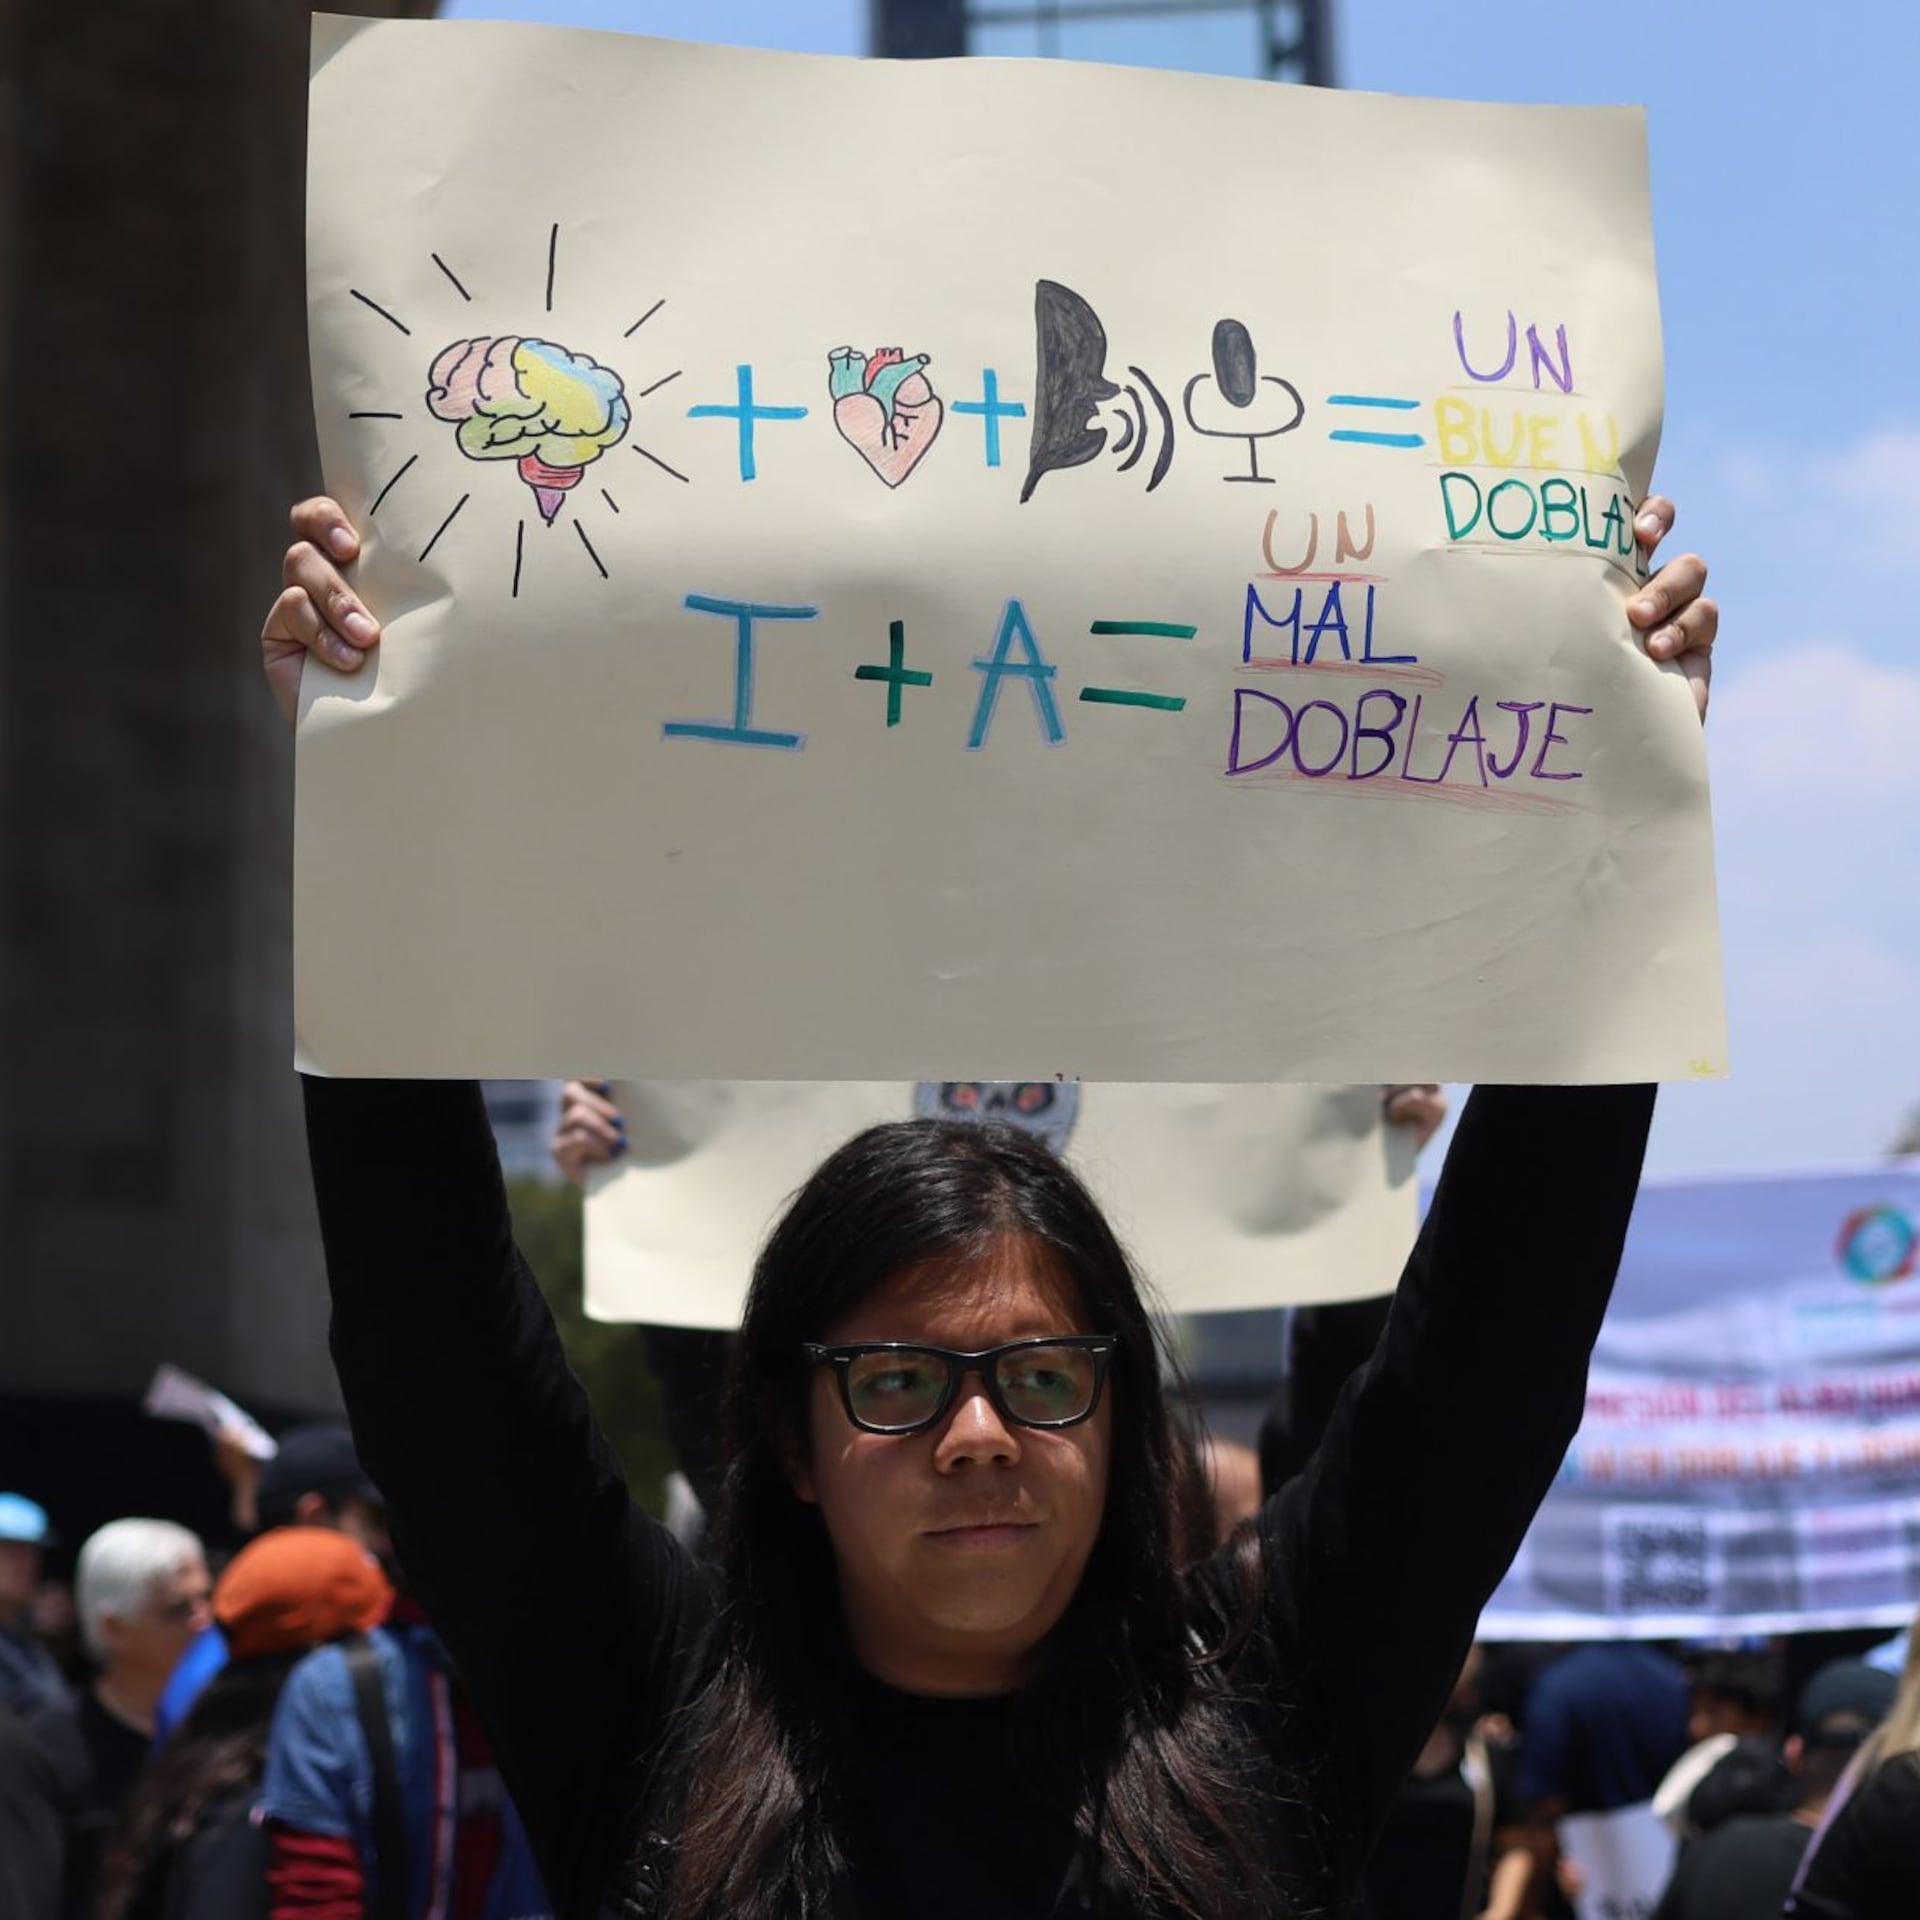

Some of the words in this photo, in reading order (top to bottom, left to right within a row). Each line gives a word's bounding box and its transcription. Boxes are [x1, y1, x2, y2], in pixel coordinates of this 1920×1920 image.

[1454, 310, 1573, 393] UN
[1434, 396, 1621, 478] BUEN
[1262, 503, 1377, 574] UN
[1243, 580, 1418, 665] MAL
[661, 593, 820, 752] I
[966, 596, 1067, 751] A
[1225, 688, 1594, 788] DOBLAJE
